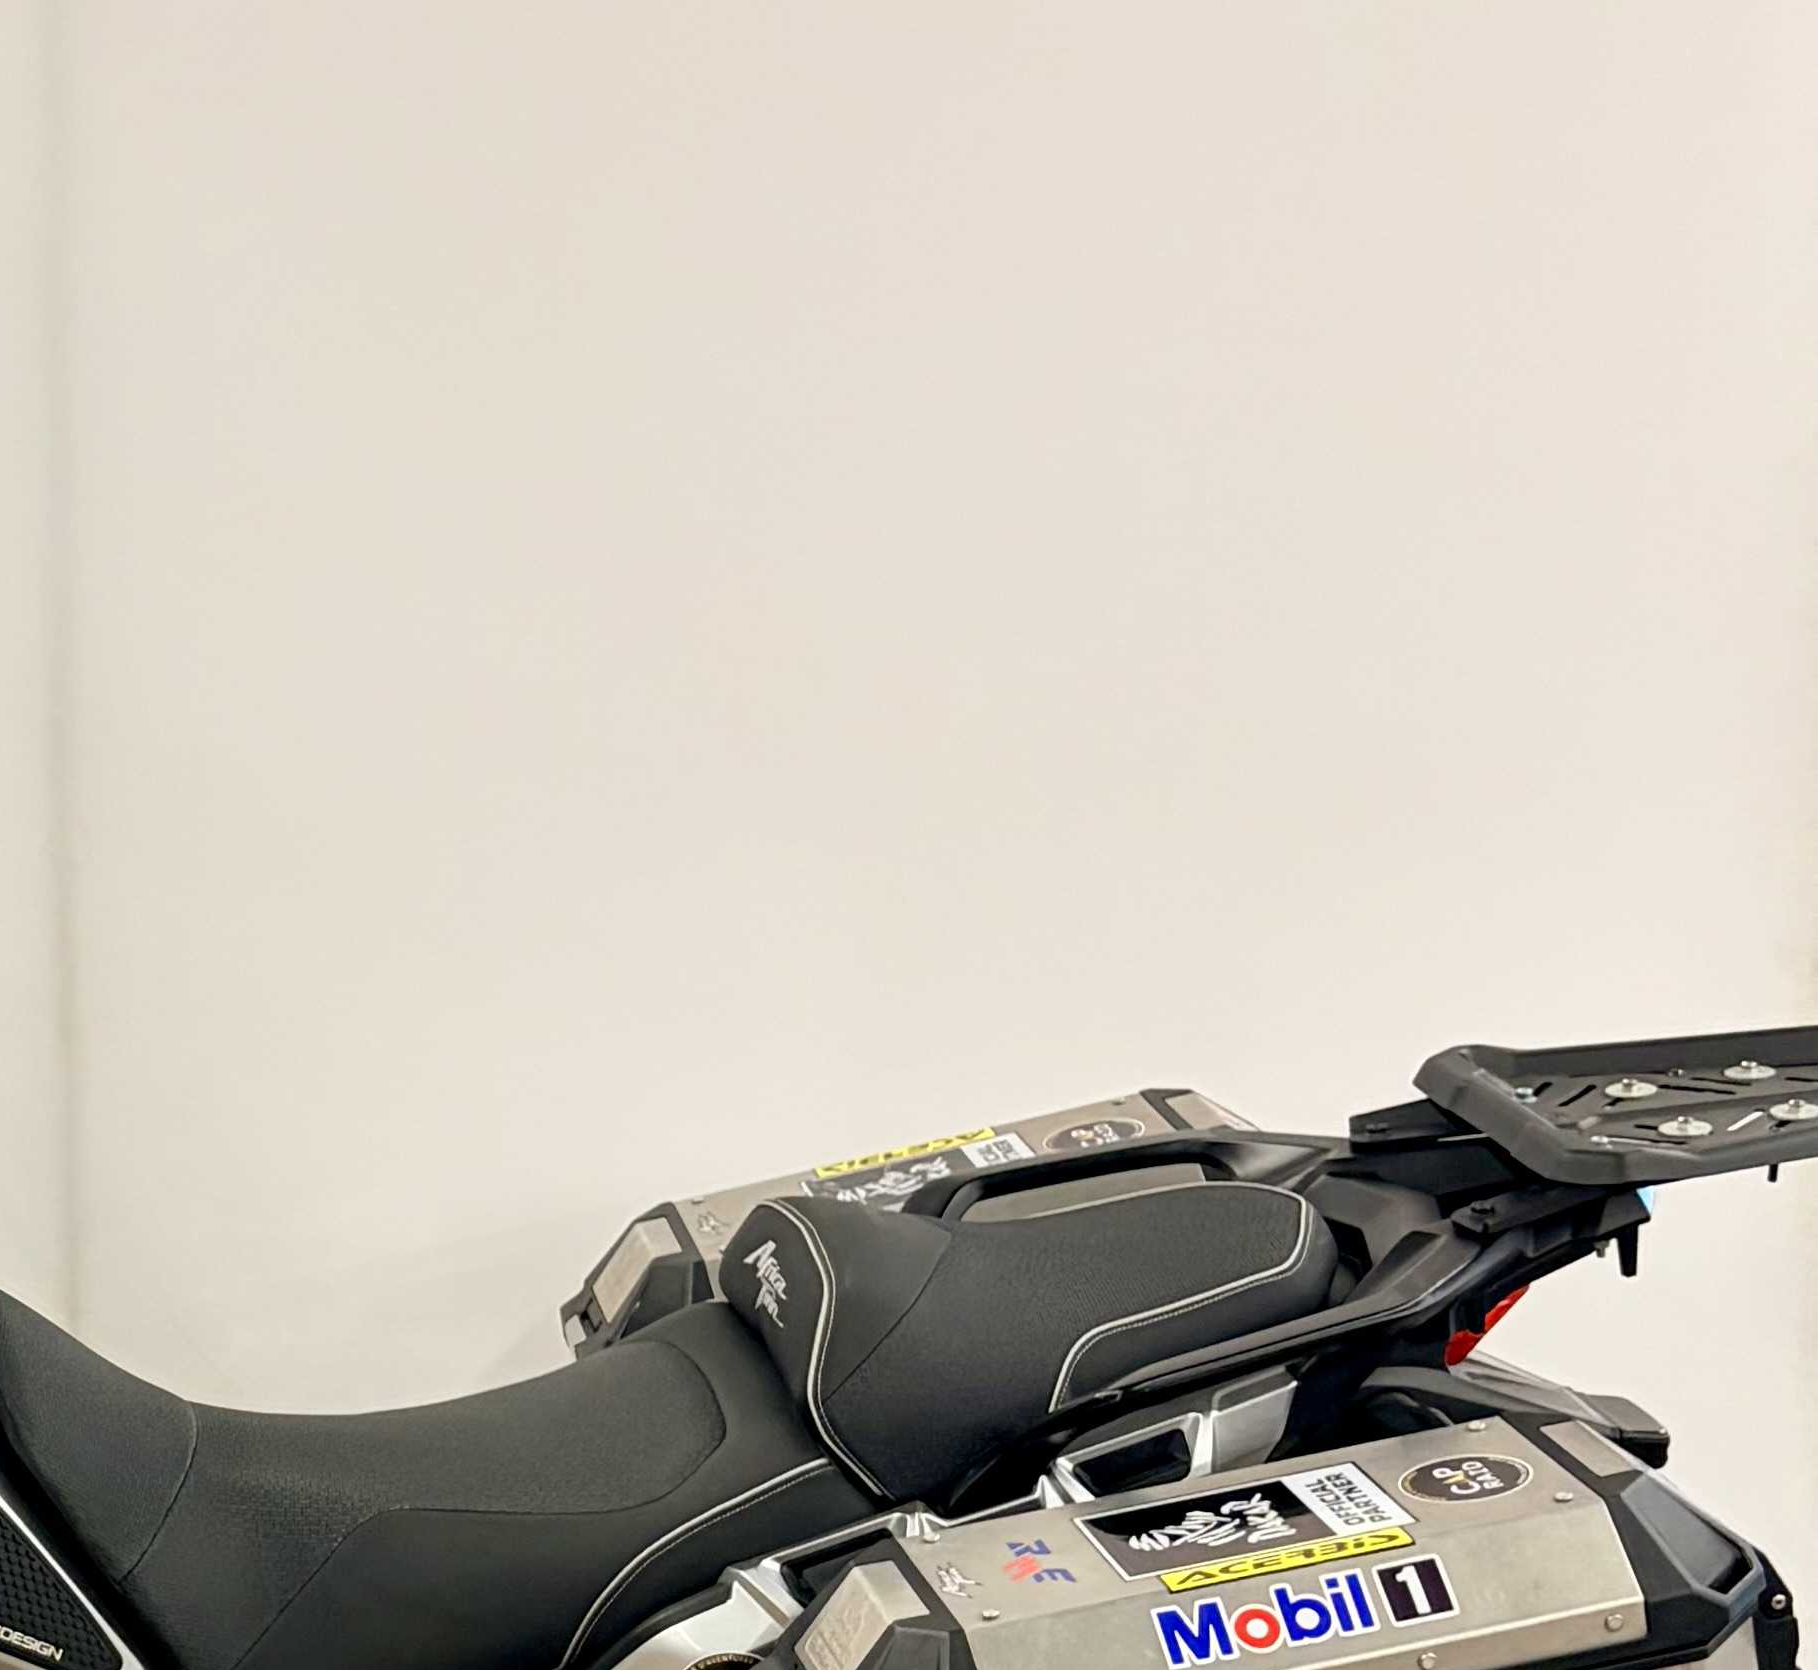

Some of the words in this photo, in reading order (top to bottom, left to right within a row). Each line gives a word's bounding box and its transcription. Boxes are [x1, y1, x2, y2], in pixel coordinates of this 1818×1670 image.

[1304, 1477, 1364, 1526] OFFICIAL
[1324, 1472, 1393, 1523] PARTNER
[1156, 1572, 1375, 1666] Mobil
